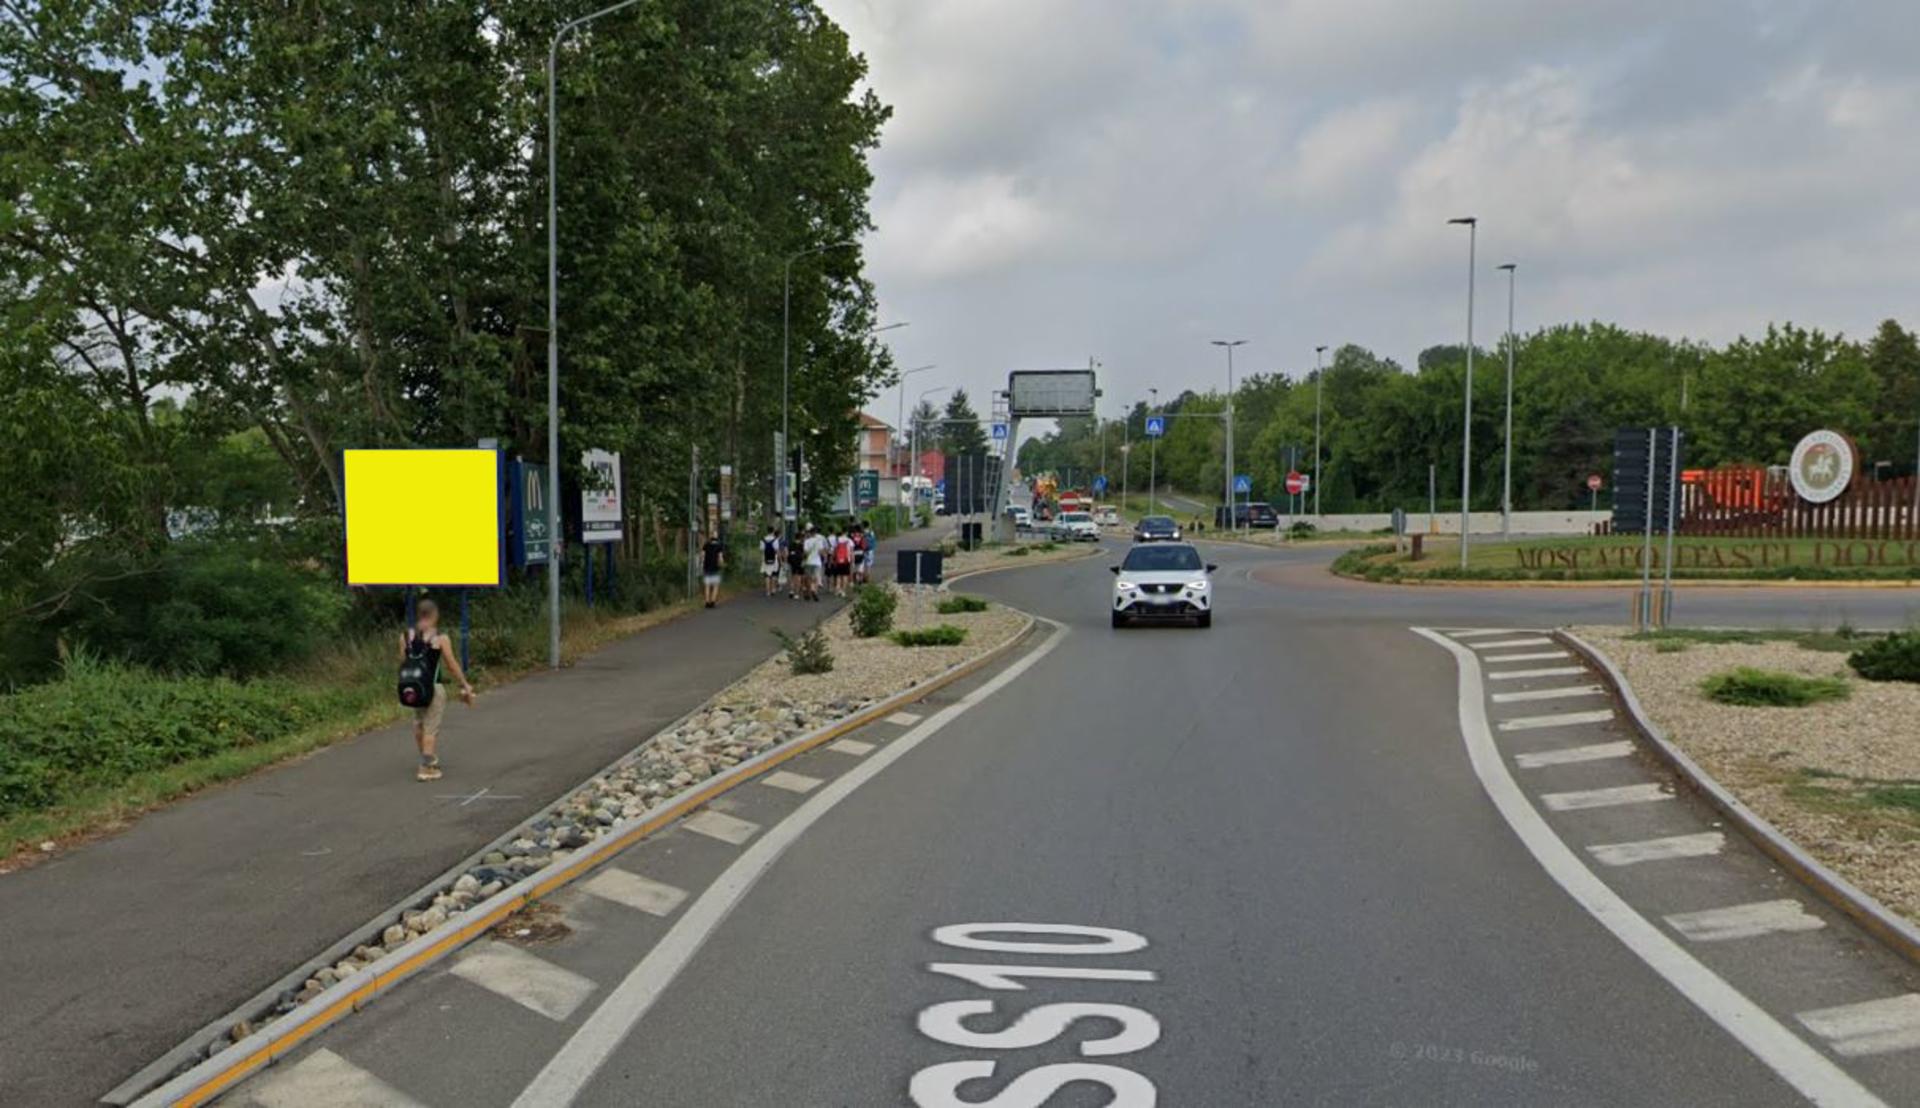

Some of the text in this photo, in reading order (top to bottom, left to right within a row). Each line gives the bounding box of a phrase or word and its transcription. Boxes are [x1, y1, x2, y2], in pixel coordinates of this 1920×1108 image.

[1516, 545, 1660, 569] MOSCATO
[1675, 543, 1791, 568] D'ASTI
[909, 922, 1160, 1108] SS10
